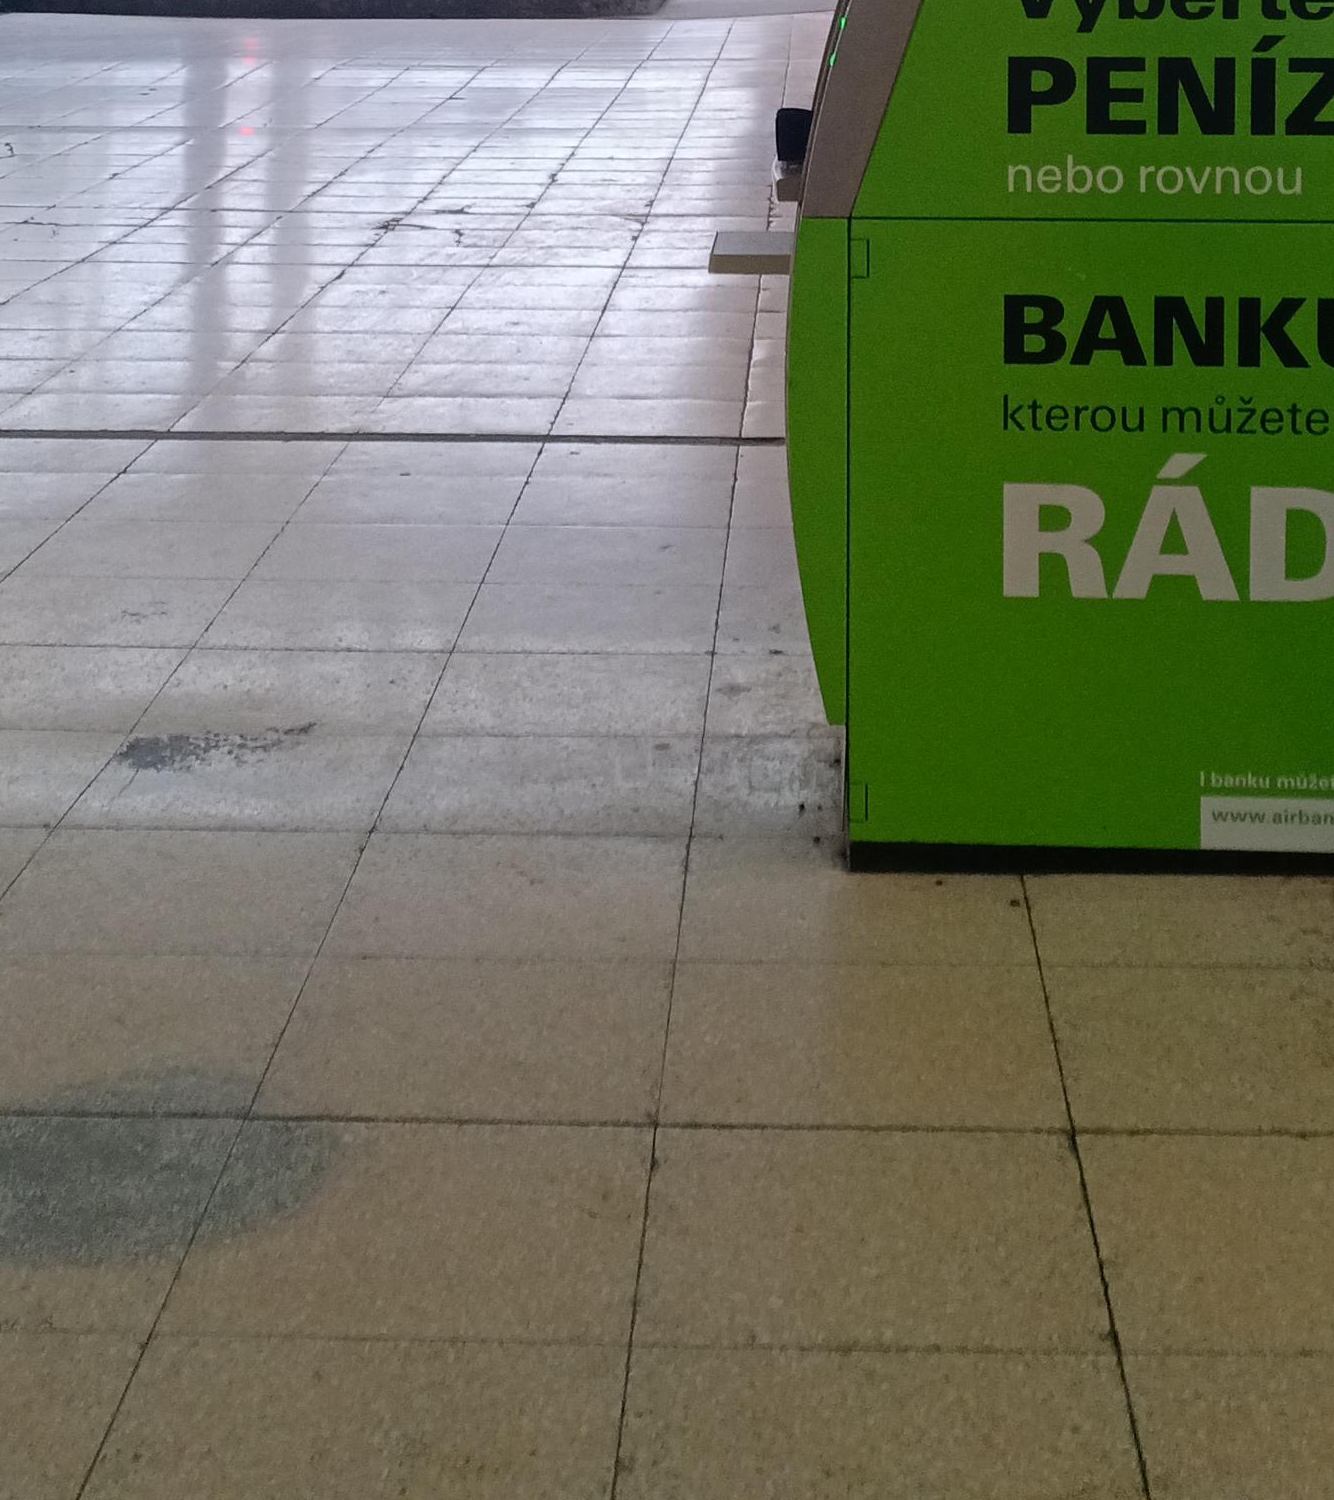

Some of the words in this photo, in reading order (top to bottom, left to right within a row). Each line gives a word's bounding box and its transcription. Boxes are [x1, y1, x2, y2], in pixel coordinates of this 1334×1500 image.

[1007, 154, 1125, 194] nebo
[1140, 164, 1303, 196] rovnou
[1002, 394, 1145, 432] kterou
[1161, 394, 1330, 436] můžete
[1210, 771, 1270, 789] banku
